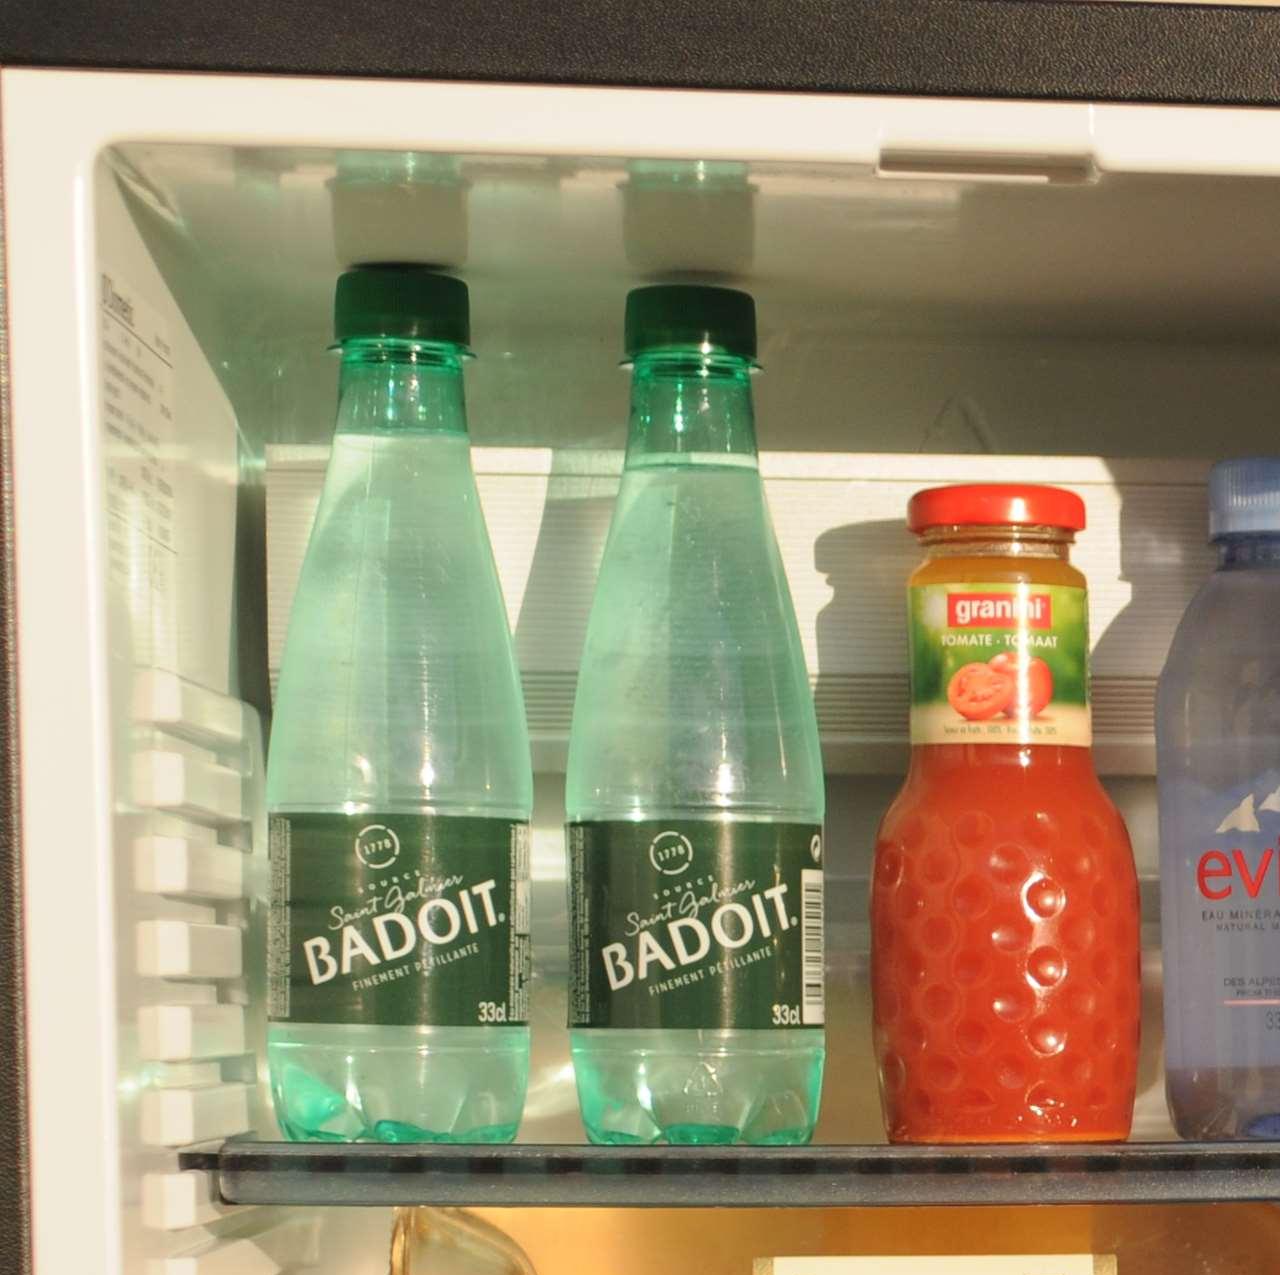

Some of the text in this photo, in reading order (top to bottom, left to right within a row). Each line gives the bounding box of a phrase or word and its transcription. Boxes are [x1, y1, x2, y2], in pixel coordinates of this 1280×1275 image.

[942, 634, 993, 648] TOMATE
[328, 897, 382, 931] Saint
[625, 903, 677, 937] Saint
[1201, 910, 1225, 922] EAU
[303, 879, 497, 986] BADOIT
[601, 884, 789, 992] BADOIT
[352, 965, 411, 992] FINEMENT
[648, 968, 706, 997] FINEMENT
[477, 1001, 507, 1023] 33cl
[772, 1004, 802, 1026] 33cl
